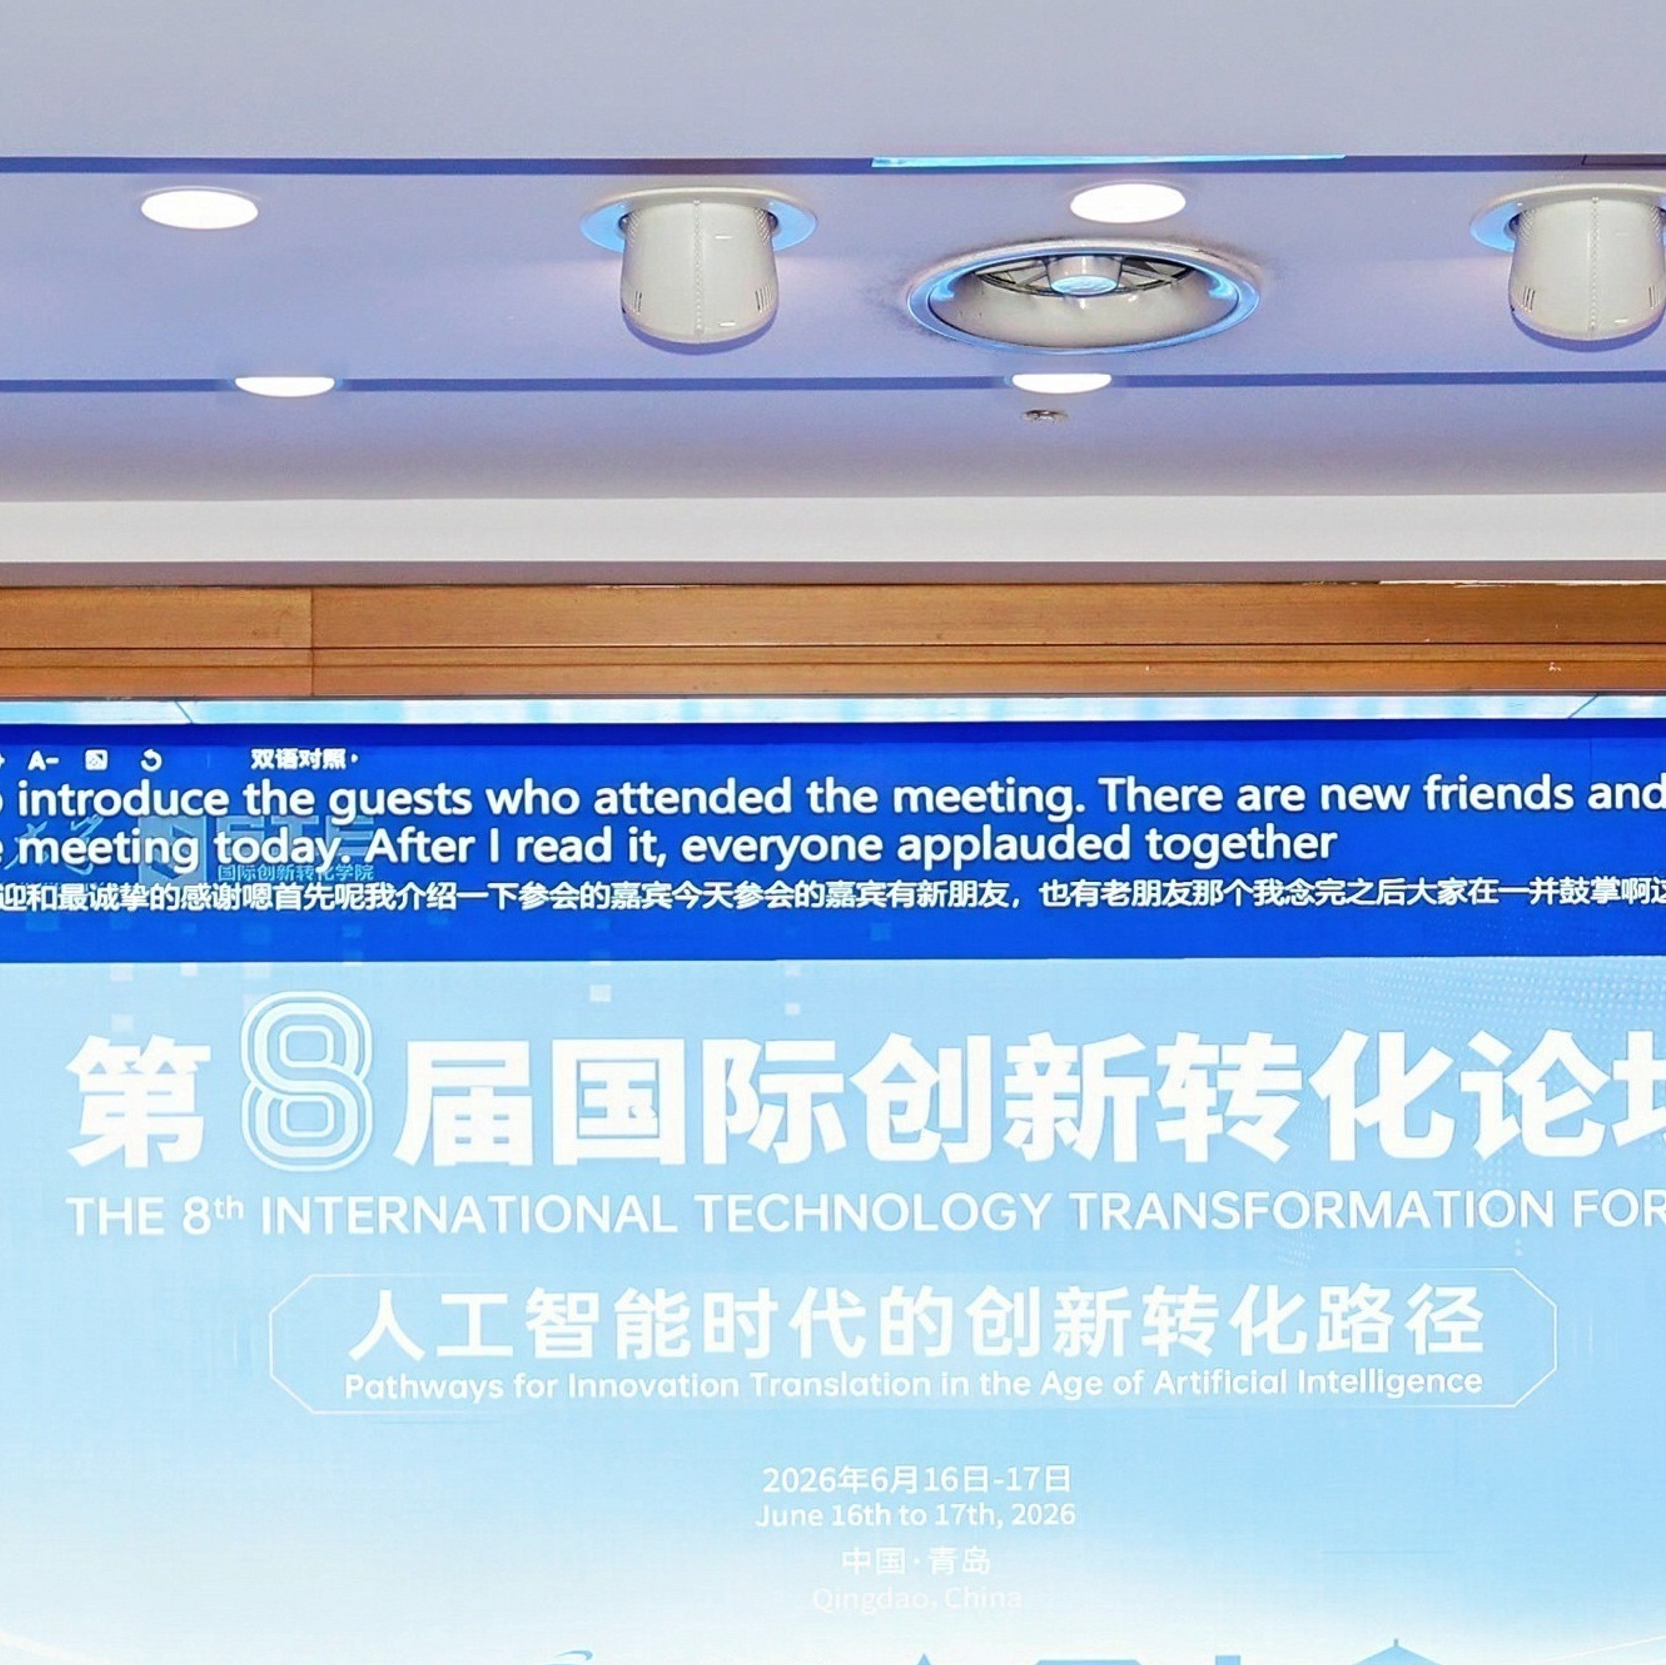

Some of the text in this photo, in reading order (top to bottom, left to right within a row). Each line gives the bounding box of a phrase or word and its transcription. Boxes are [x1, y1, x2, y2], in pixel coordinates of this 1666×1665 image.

[252, 748, 345, 769] 双语对照
[20, 780, 228, 815] introduce
[244, 779, 314, 814] the
[330, 784, 471, 822] guests
[487, 779, 579, 813] who
[595, 777, 790, 813] attended
[807, 777, 877, 812] the
[895, 778, 1084, 820] meeting.
[1099, 777, 1222, 811] There
[1238, 786, 1304, 810] are
[1322, 785, 1409, 809] new
[1424, 774, 1573, 809] friends
[20, 828, 197, 872] meeting
[214, 827, 349, 872] today.
[365, 827, 474, 862] After
[492, 829, 497, 861] I
[518, 827, 610, 862] read
[630, 827, 665, 866] it,
[683, 836, 882, 870] everyone
[899, 825, 1129, 869] applauded
[1146, 824, 1337, 868] together
[66, 1197, 164, 1236] THE
[183, 1195, 244, 1235] 8th
[263, 1195, 677, 1234] INTERNATIONAL
[695, 1193, 1052, 1232] TECHNOLOGY
[1069, 1190, 1553, 1229] TRANSFORMATION
[348, 1284, 1483, 1362] 人工智能时代的创新转化路径
[346, 1369, 1482, 1403] Pathways for Innovation Translation in the Age of Artificial Intelligence
[763, 1466, 1069, 1494] 2026年6月16日-17日
[755, 1503, 1075, 1529] June 16th to 17th, 2026
